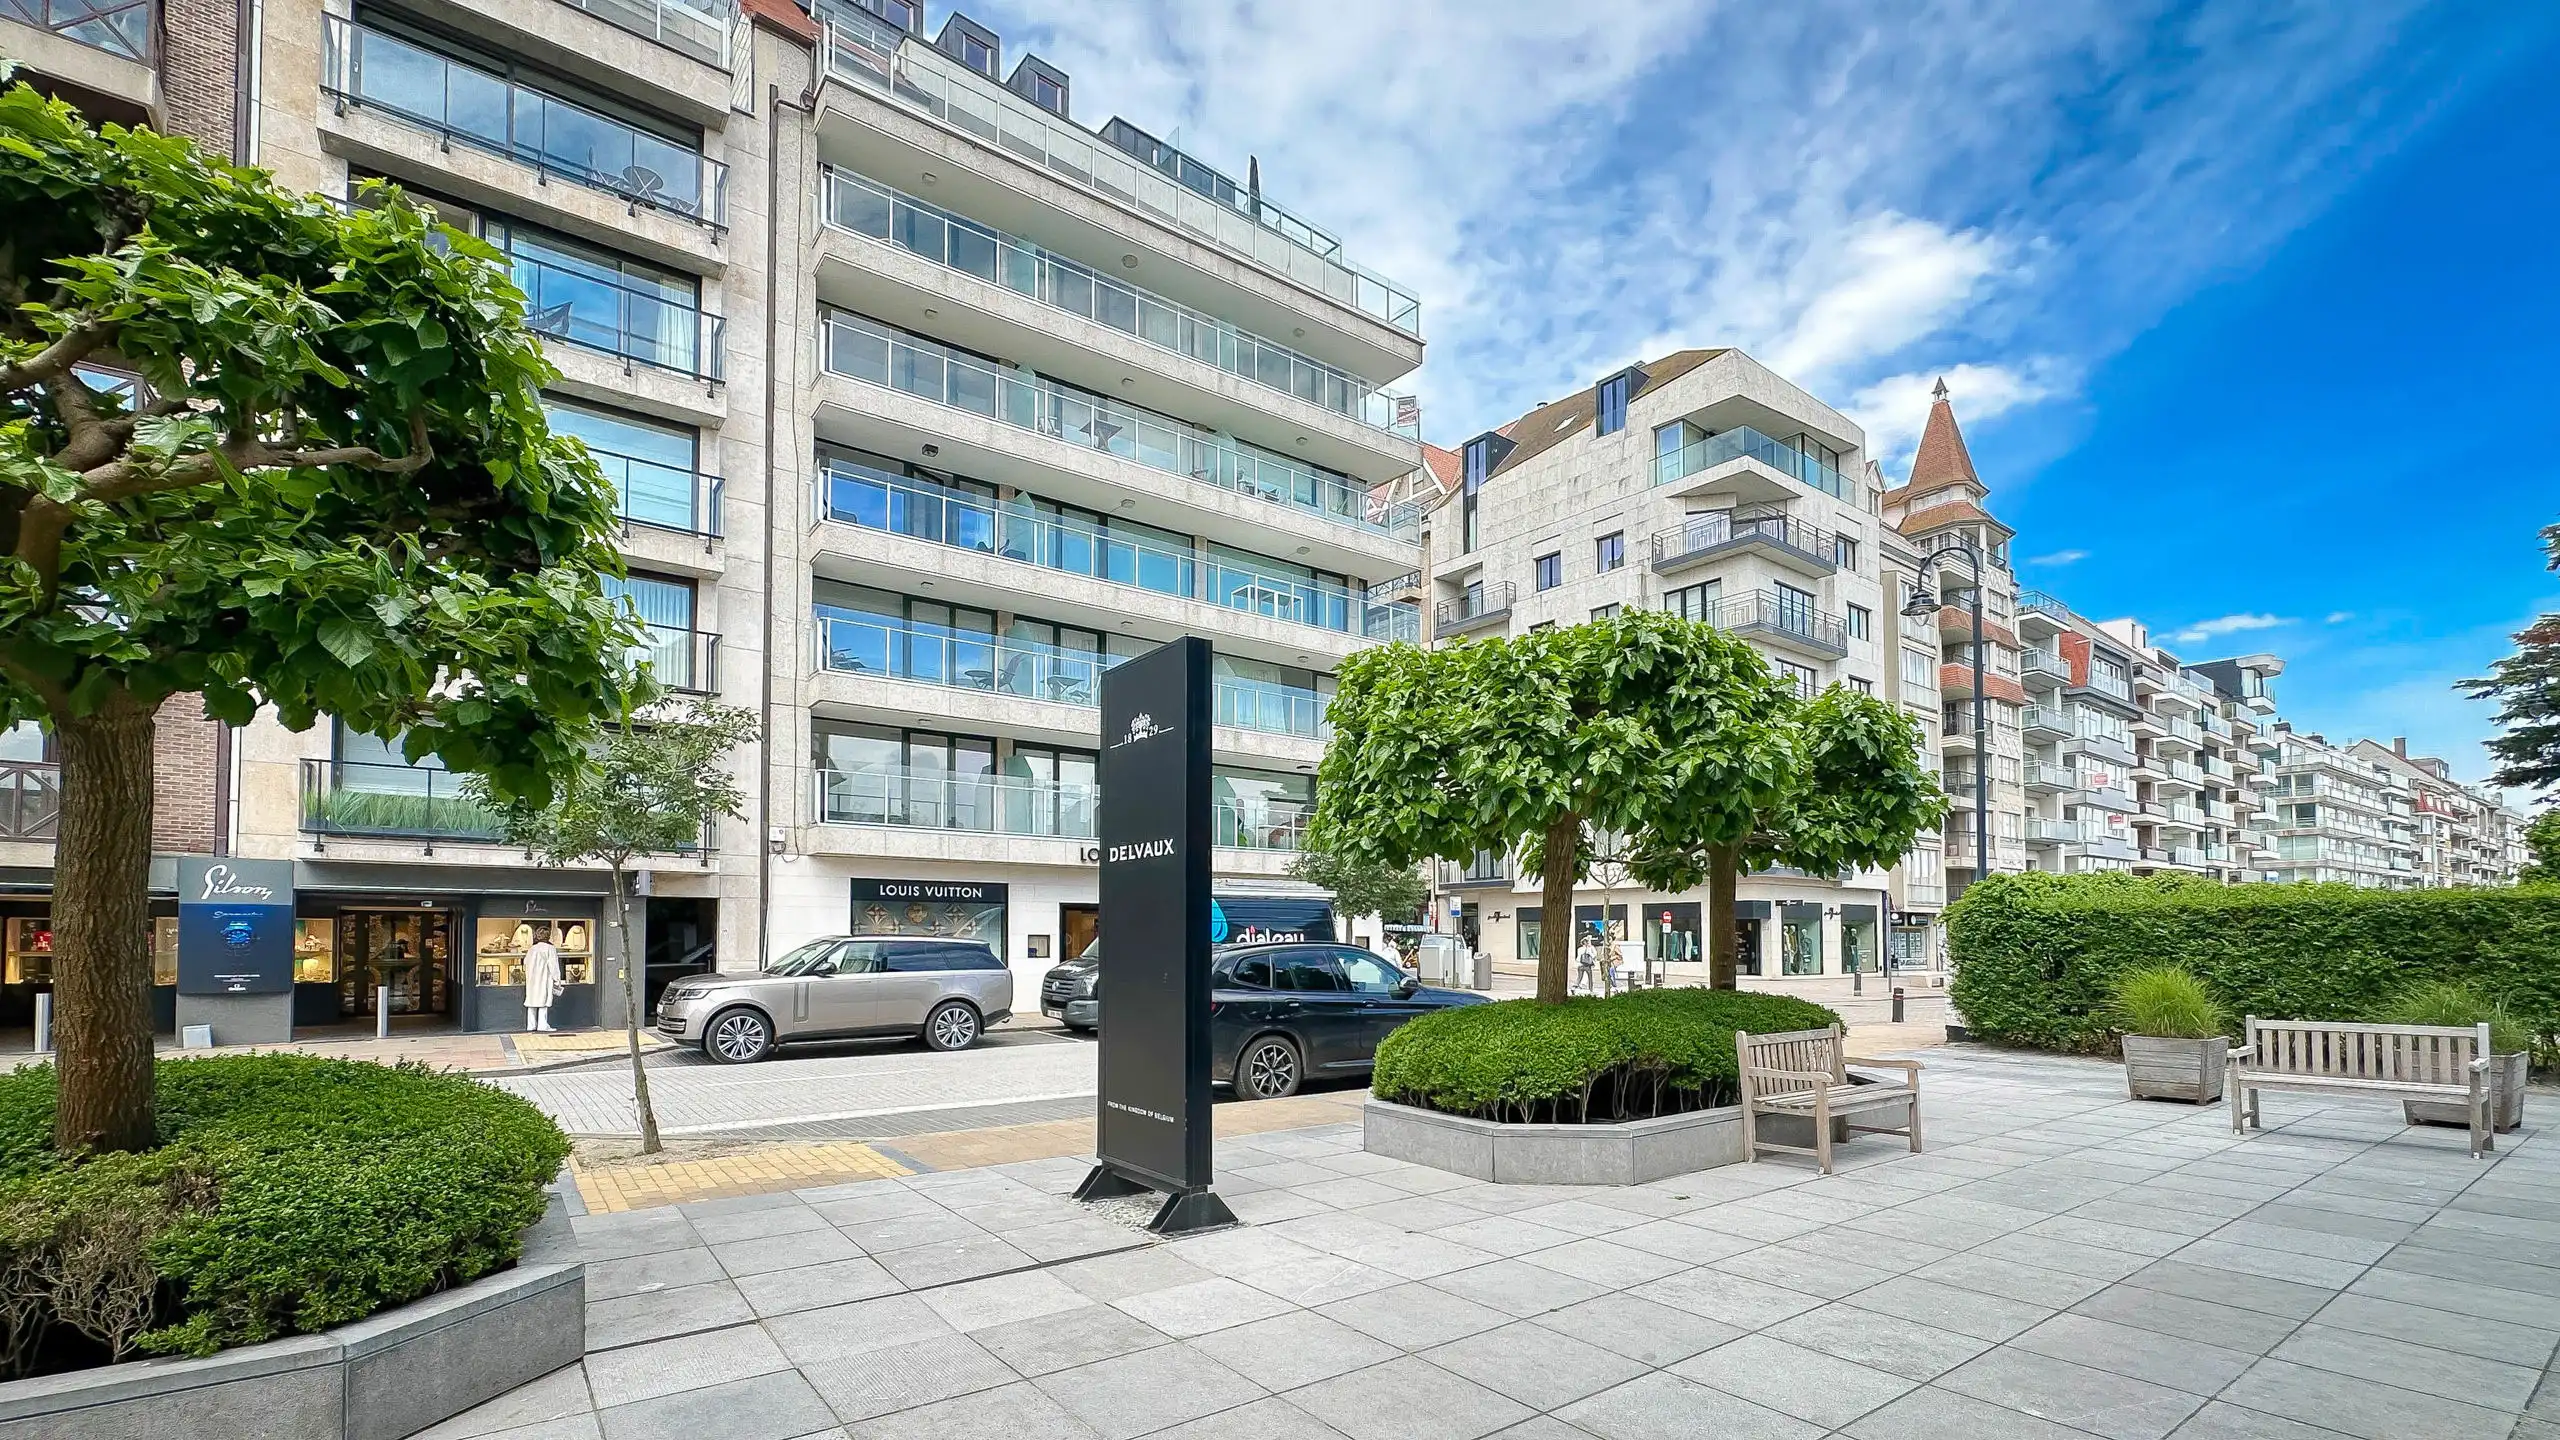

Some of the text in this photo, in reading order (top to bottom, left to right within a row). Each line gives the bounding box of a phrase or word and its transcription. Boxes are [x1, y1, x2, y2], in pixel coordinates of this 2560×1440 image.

[1109, 838, 1175, 863] DELVAUX
[201, 864, 273, 901] Gilson
[879, 884, 982, 898] LOUIS VUITTON
